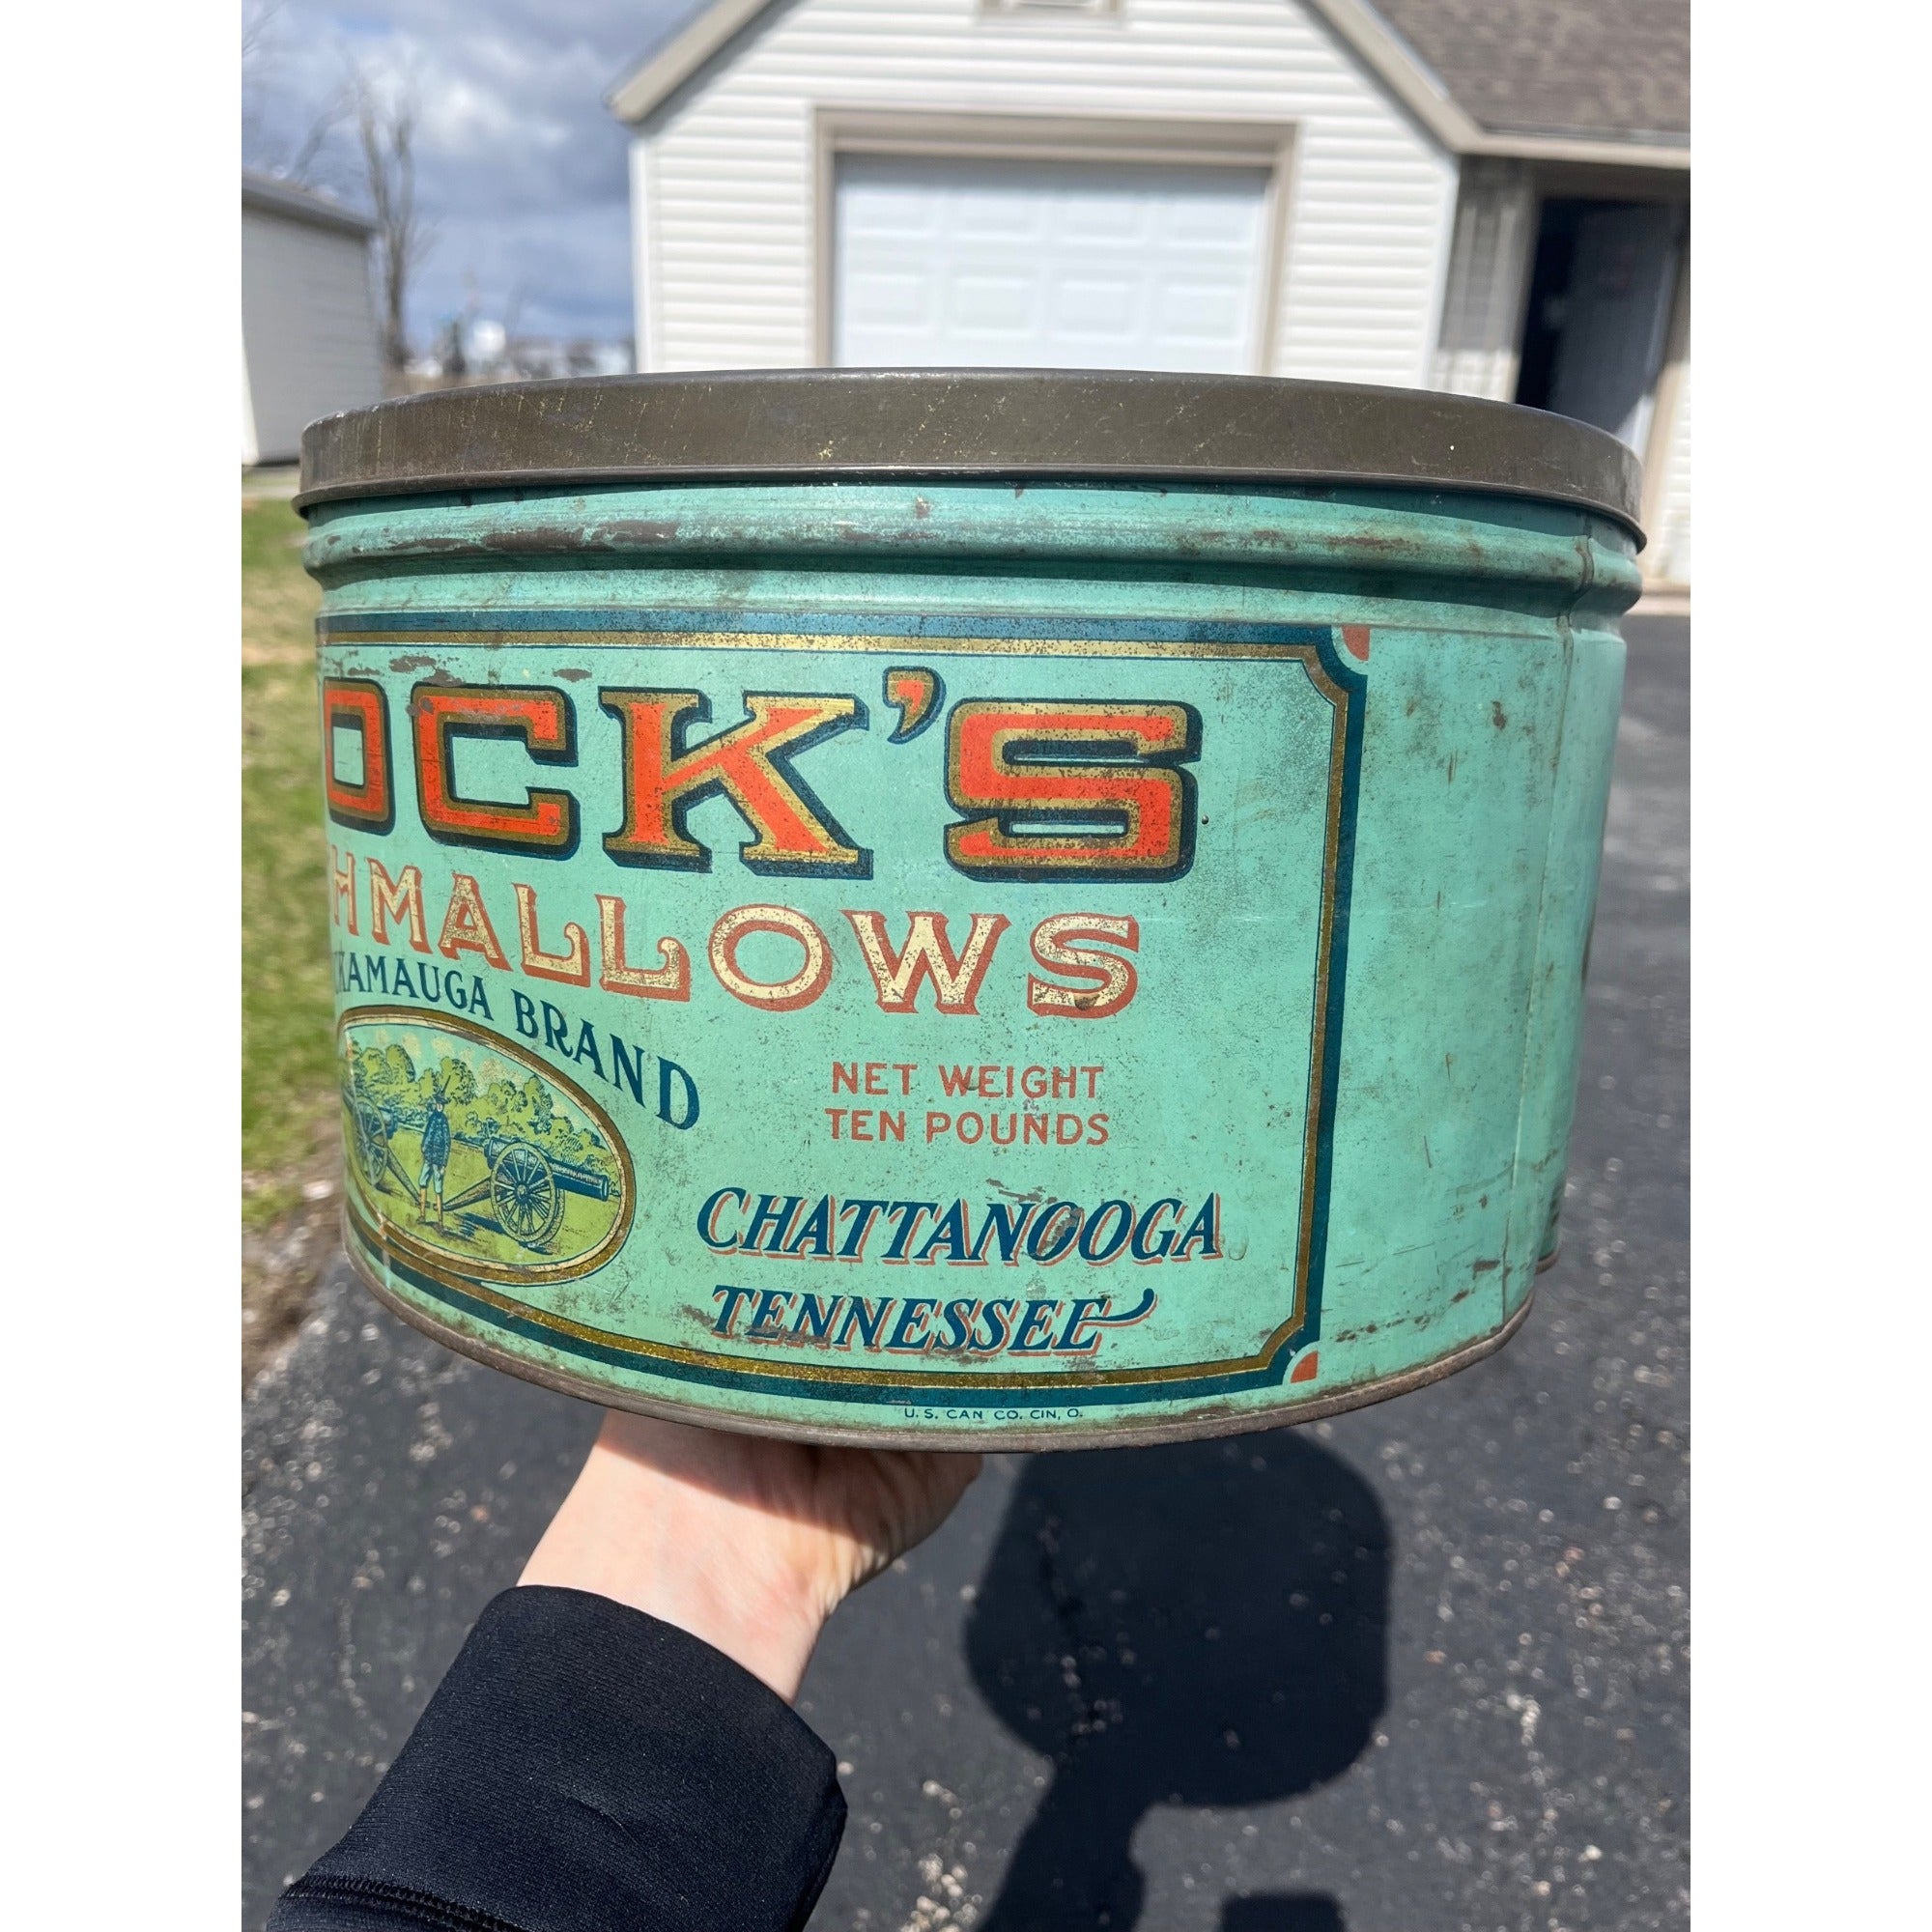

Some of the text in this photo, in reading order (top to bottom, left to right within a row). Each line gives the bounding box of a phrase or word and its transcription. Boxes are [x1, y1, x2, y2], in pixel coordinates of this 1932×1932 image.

[332, 844, 1141, 1019] HMALLOWS
[511, 988, 701, 1130] BRAND
[832, 1062, 1104, 1099] NET WEIGHT
[825, 1108, 1109, 1146] TEN POUNDS
[696, 1186, 1223, 1266] CHATTANOOGA
[711, 1284, 1158, 1355] TENNESSEE
[946, 1408, 983, 1420] CAN
[993, 1409, 1023, 1420] CO.
[1066, 1407, 1083, 1418] O.
